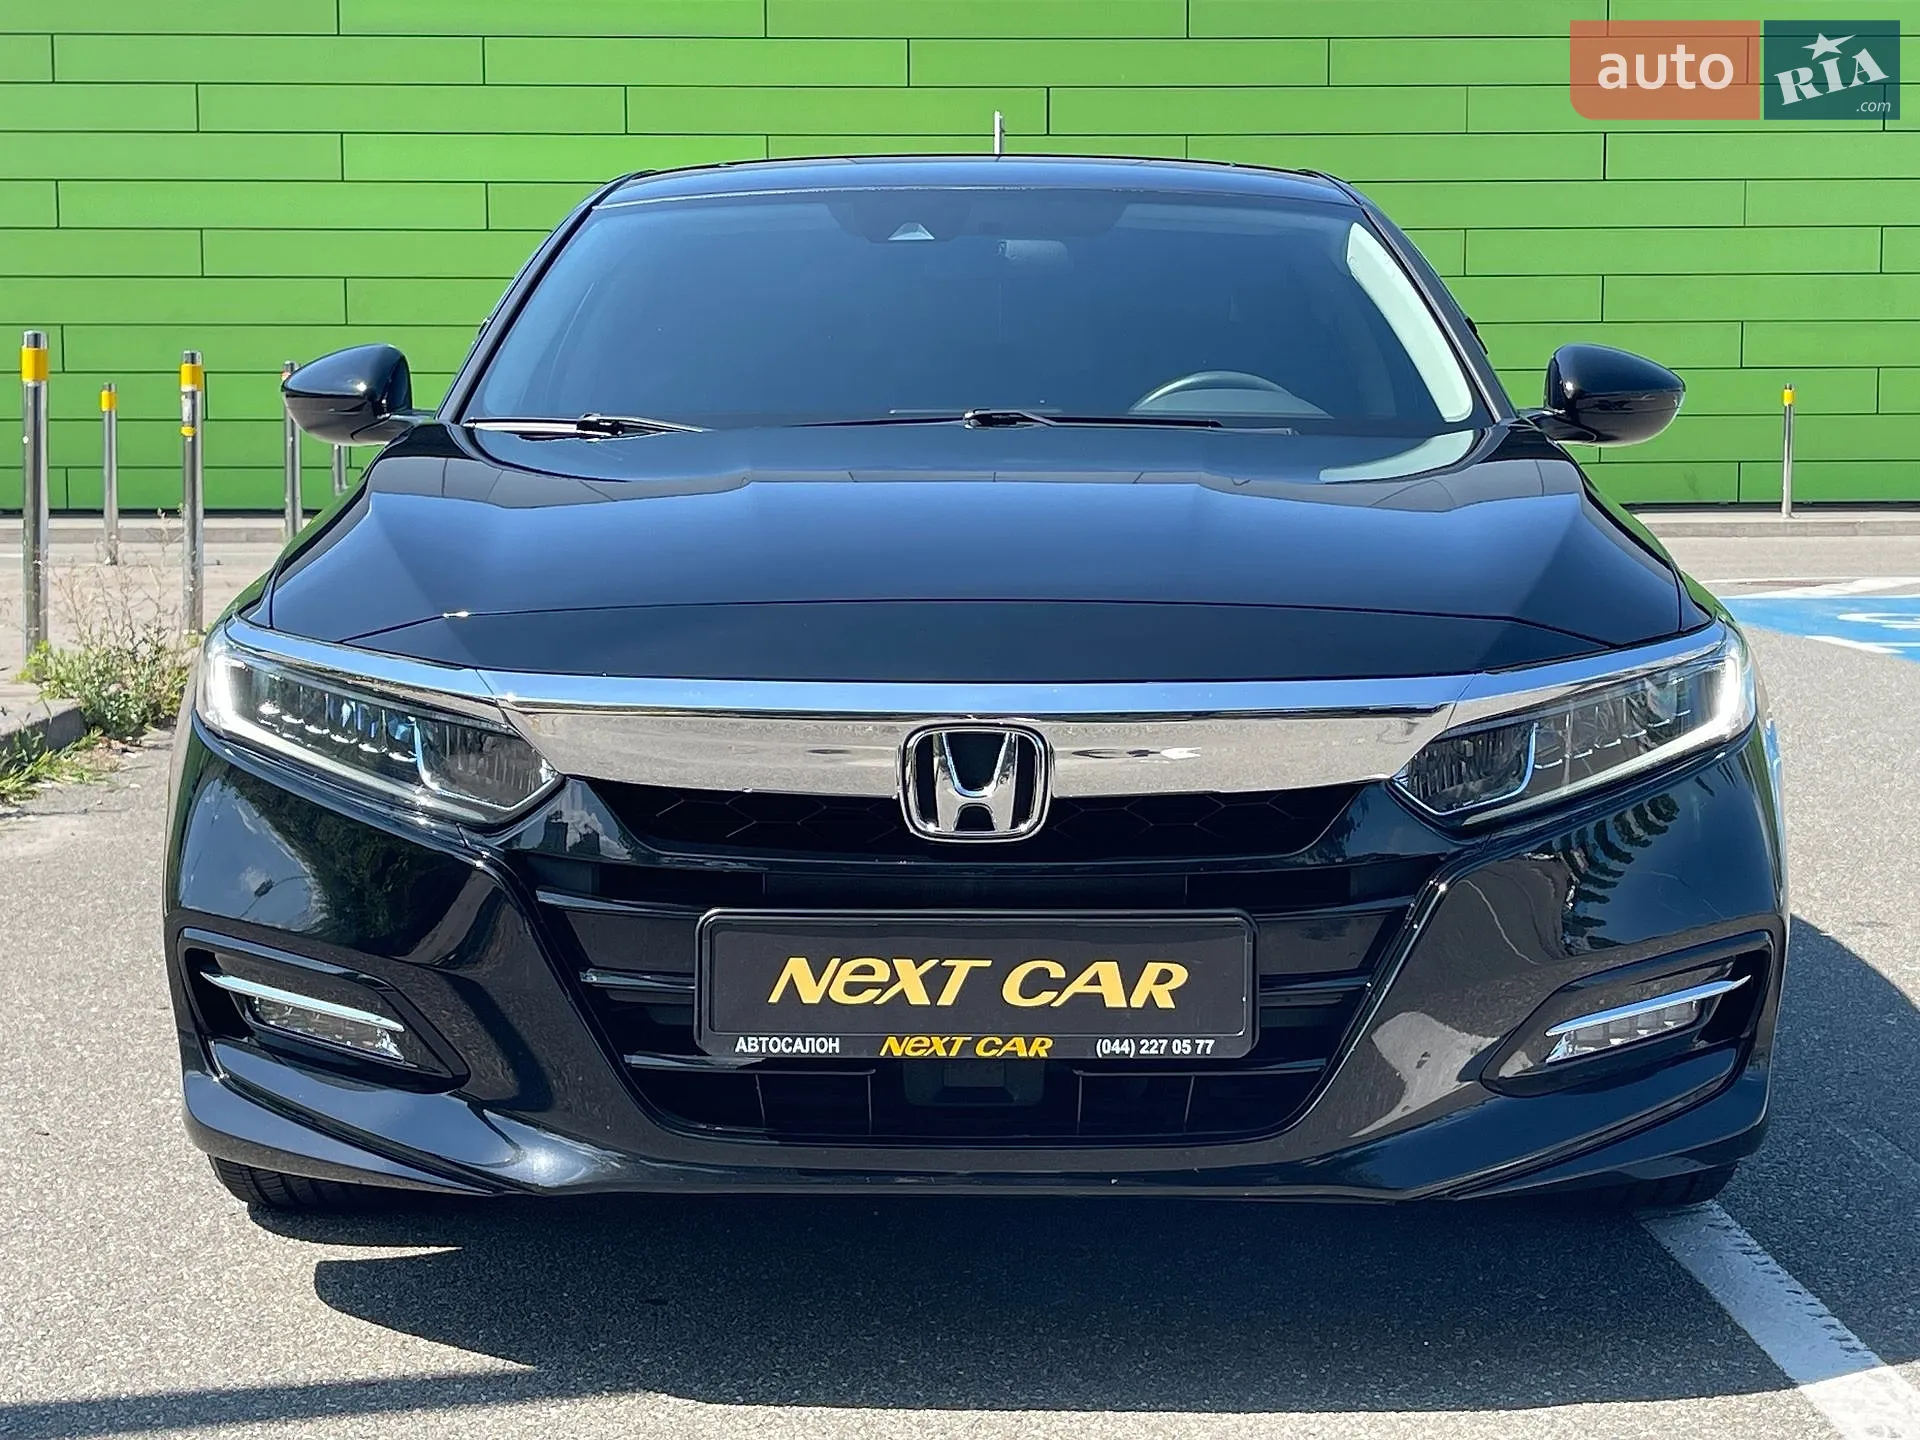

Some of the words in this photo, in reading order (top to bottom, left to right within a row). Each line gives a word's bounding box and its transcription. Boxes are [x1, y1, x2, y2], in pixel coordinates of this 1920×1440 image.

[1001, 960, 1190, 1009] CAR
[734, 1036, 840, 1054] АВТОСАЛОН
[974, 1036, 1054, 1058] CAR
[1096, 1038, 1136, 1059] (044)
[1139, 1038, 1169, 1055] 227
[1171, 1038, 1192, 1055] 05
[1194, 1038, 1216, 1055] 77
